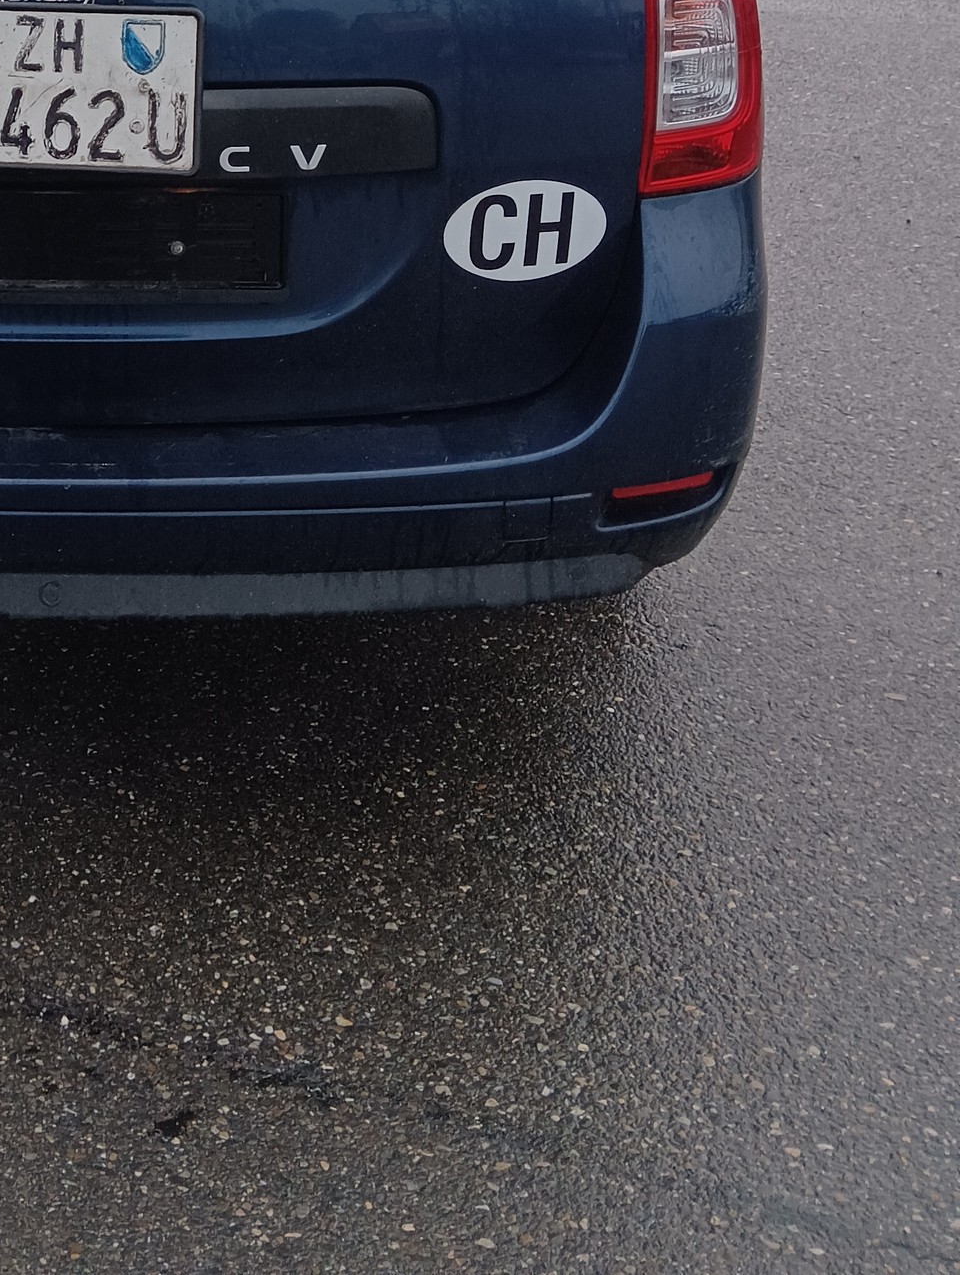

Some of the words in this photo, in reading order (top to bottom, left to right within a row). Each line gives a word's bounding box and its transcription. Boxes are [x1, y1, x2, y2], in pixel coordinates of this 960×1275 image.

[14, 14, 84, 73] ZH
[218, 143, 328, 173] CV
[469, 191, 575, 271] CH
